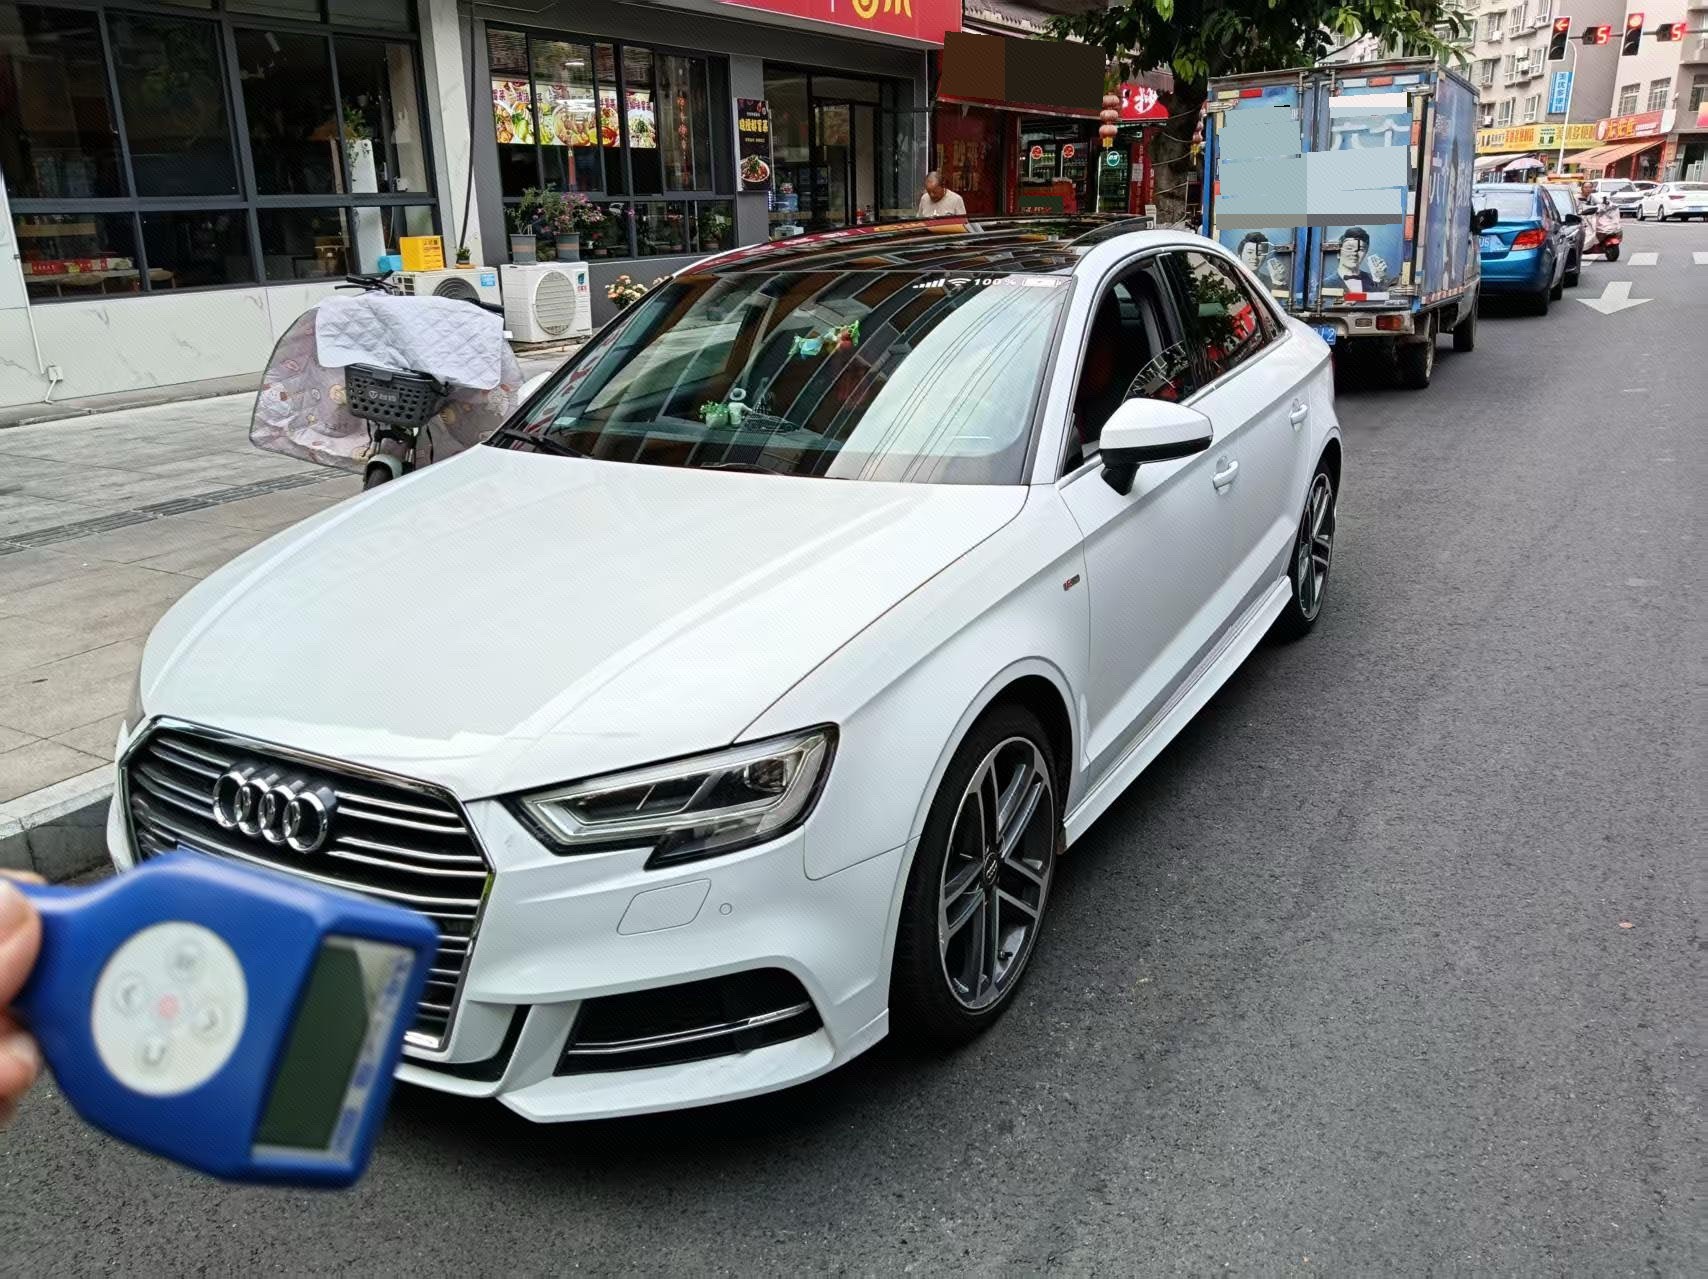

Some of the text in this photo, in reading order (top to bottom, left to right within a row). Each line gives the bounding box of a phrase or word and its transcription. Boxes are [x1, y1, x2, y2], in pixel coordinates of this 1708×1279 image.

[1596, 27, 1608, 44] 5
[1671, 23, 1683, 41] 5
[974, 278, 1001, 286] 100
